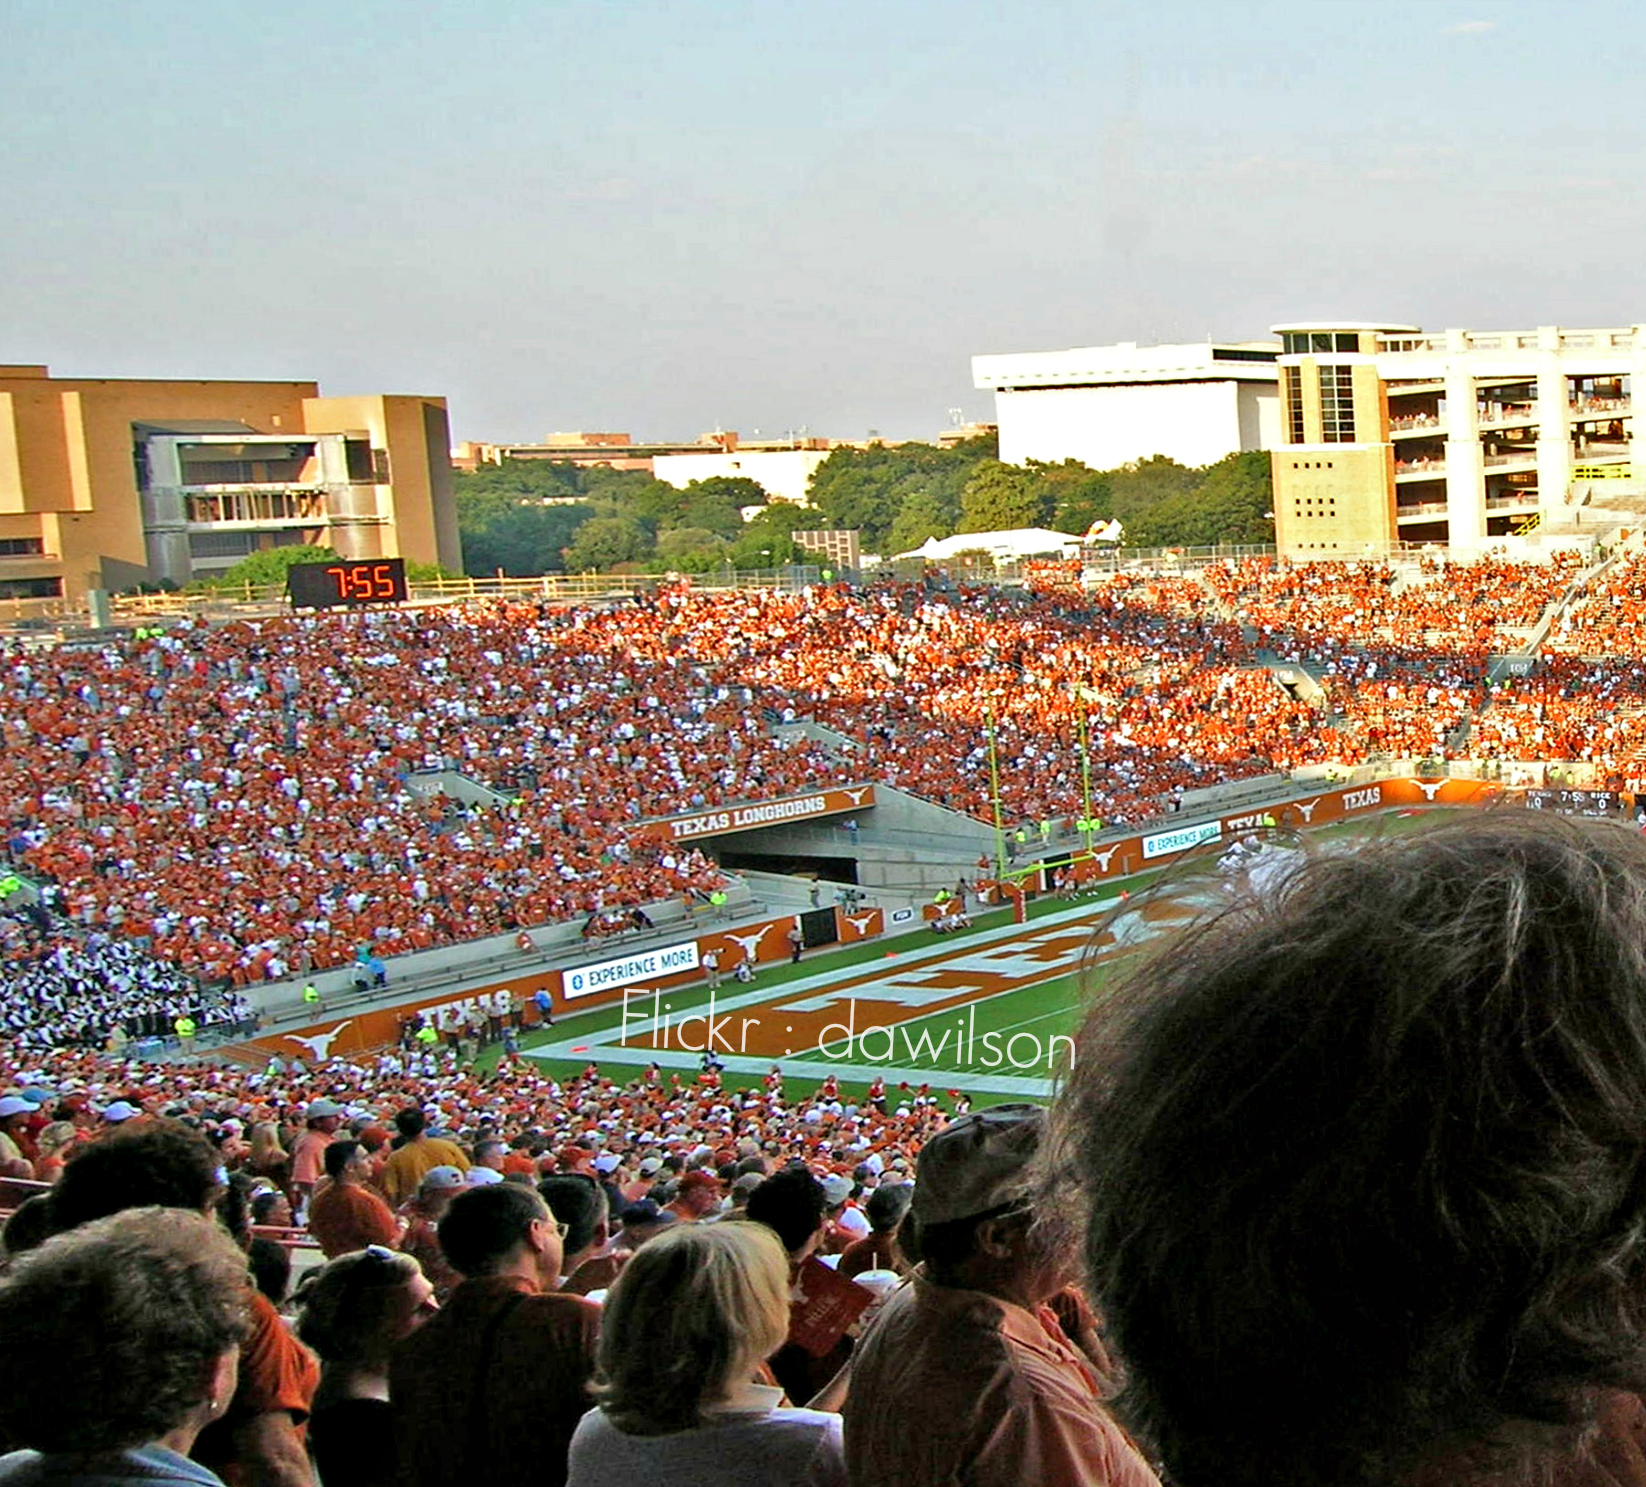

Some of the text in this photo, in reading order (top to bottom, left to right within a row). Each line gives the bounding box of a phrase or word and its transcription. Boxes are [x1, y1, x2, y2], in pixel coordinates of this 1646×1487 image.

[326, 564, 395, 598] 7:55
[1341, 786, 1381, 811] TEXAS
[670, 796, 827, 837] TEXAS LONGHORNS
[1157, 829, 1198, 851] EXPERIENCE
[588, 946, 694, 986] EXPERIENCE MORE
